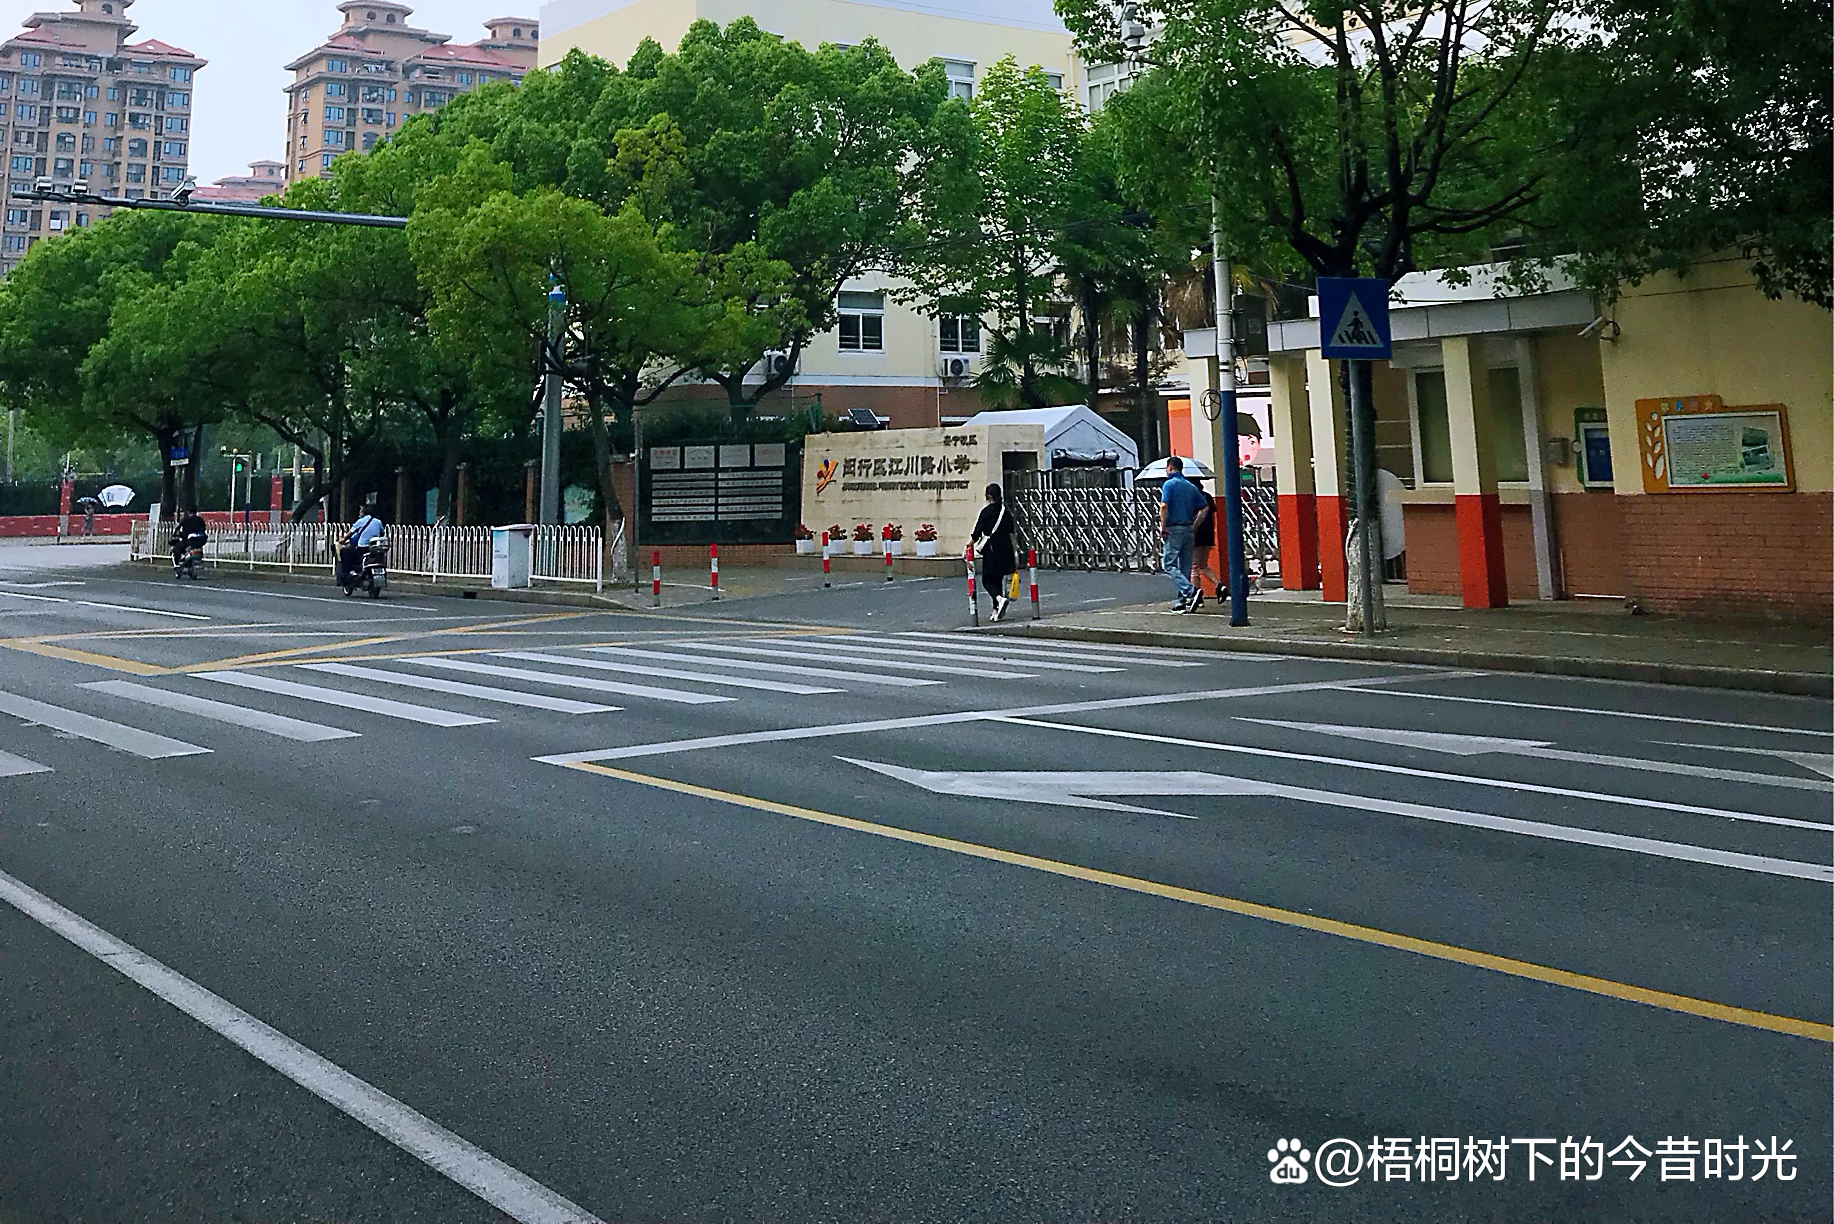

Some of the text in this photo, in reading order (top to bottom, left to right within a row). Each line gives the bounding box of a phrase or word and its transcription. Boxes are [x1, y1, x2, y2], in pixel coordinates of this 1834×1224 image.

[843, 454, 971, 477] 闵行区江川路小学
